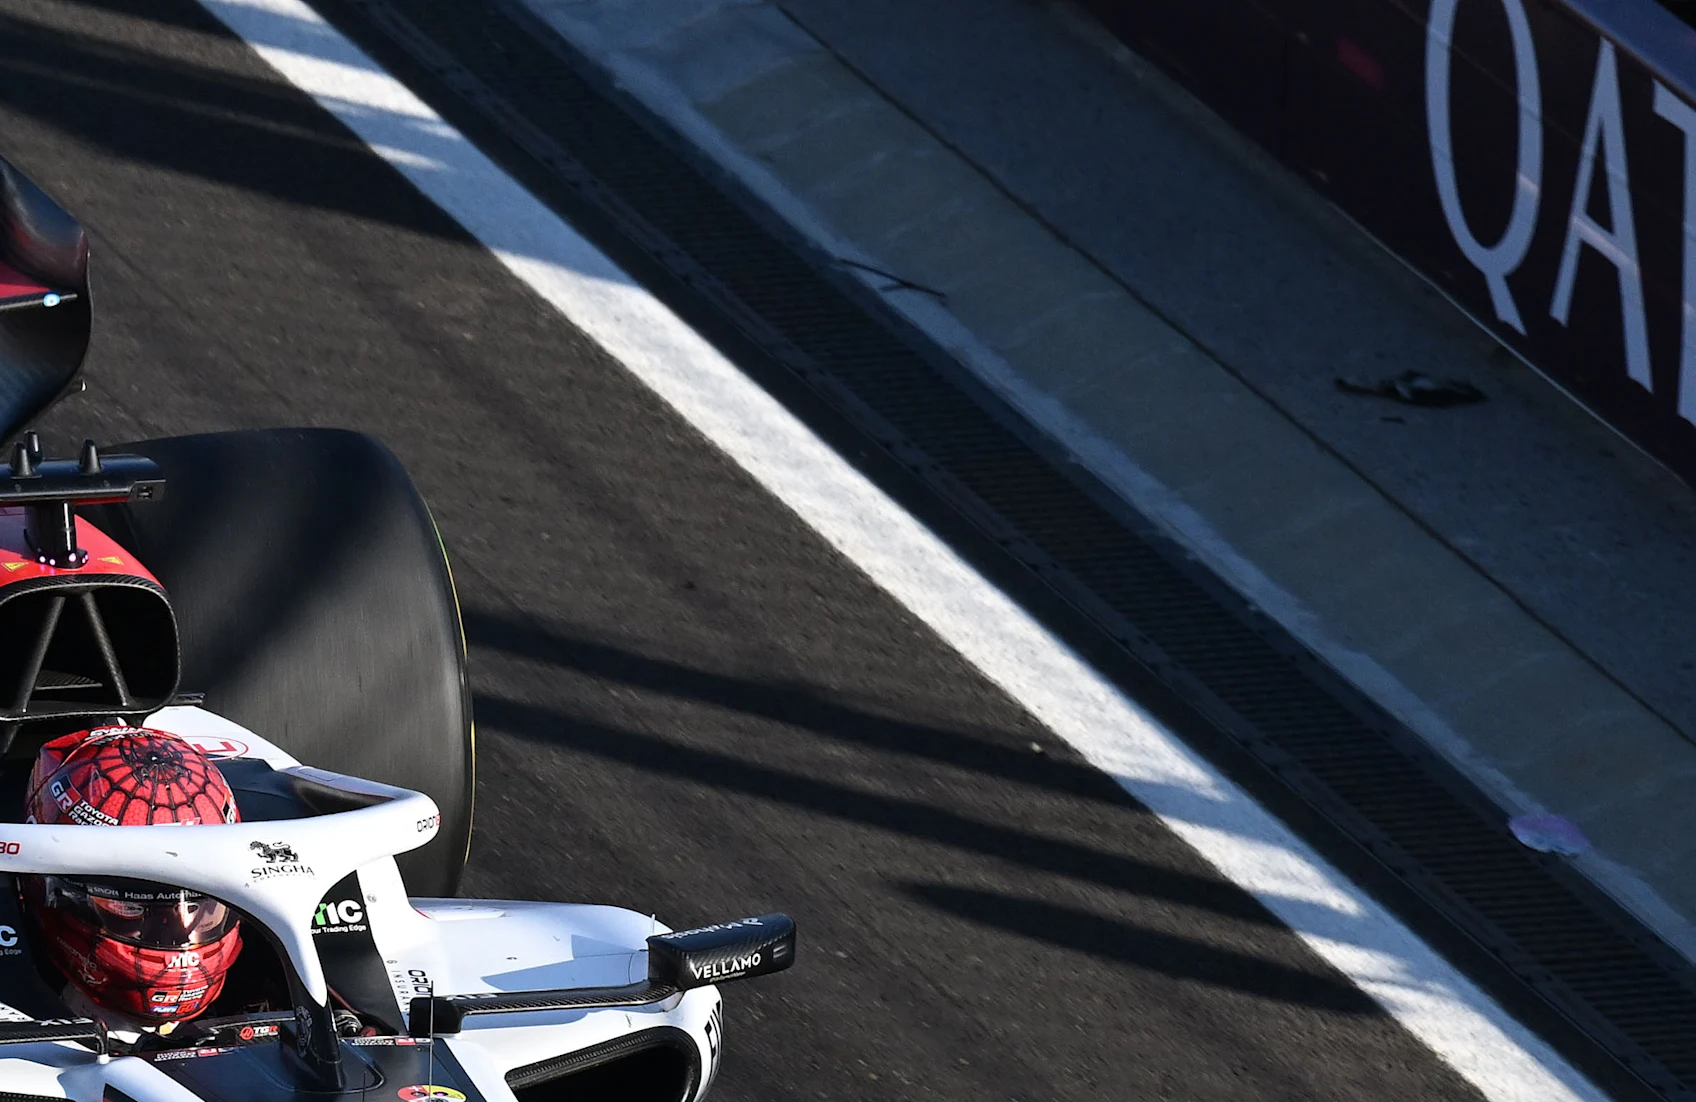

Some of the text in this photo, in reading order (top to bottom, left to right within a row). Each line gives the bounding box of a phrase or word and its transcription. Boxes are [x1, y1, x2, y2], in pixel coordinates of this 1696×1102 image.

[50, 780, 74, 811] GR
[80, 800, 120, 825] TOYOTA
[251, 865, 315, 879] SINGHA
[124, 891, 154, 900] Haas
[690, 953, 762, 980] VELLAMO
